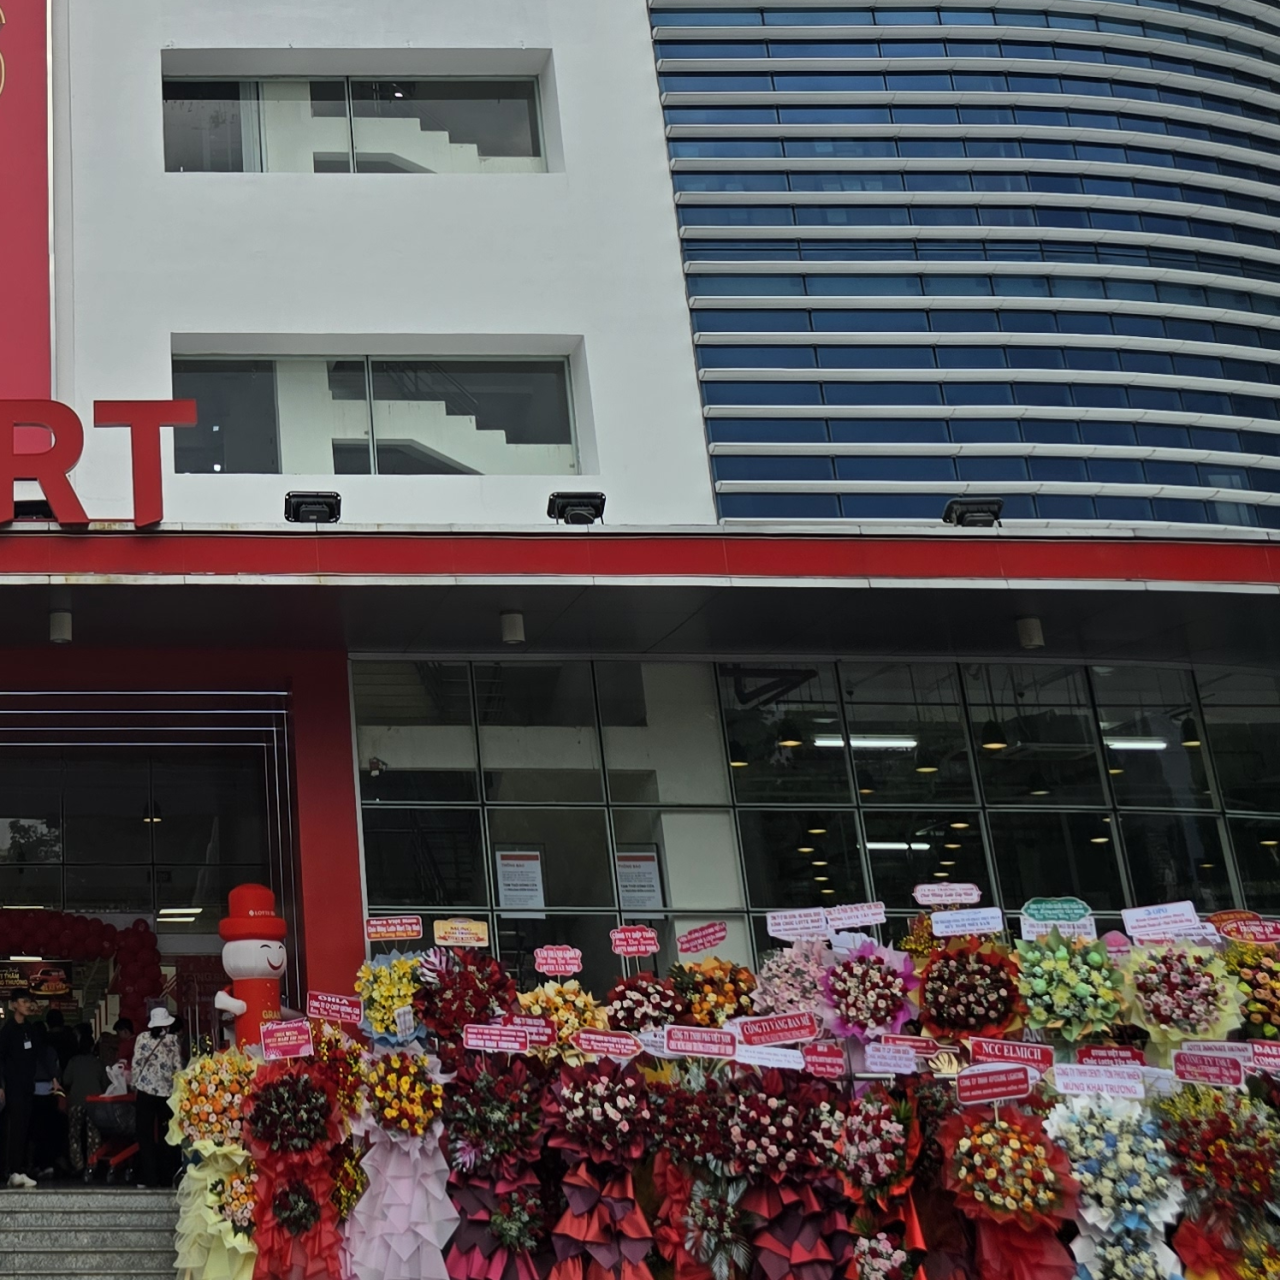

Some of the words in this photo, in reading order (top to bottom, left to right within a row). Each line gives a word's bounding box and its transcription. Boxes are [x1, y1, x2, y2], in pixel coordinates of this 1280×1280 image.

[318, 995, 349, 1005] OHLA
[744, 1021, 762, 1035] CÔNG
[761, 1021, 770, 1032] TY
[982, 1042, 1002, 1055] NCC
[1003, 1045, 1042, 1060] ELMICH
[1253, 1044, 1280, 1055] DAE
[1086, 1083, 1103, 1092] KHAI
